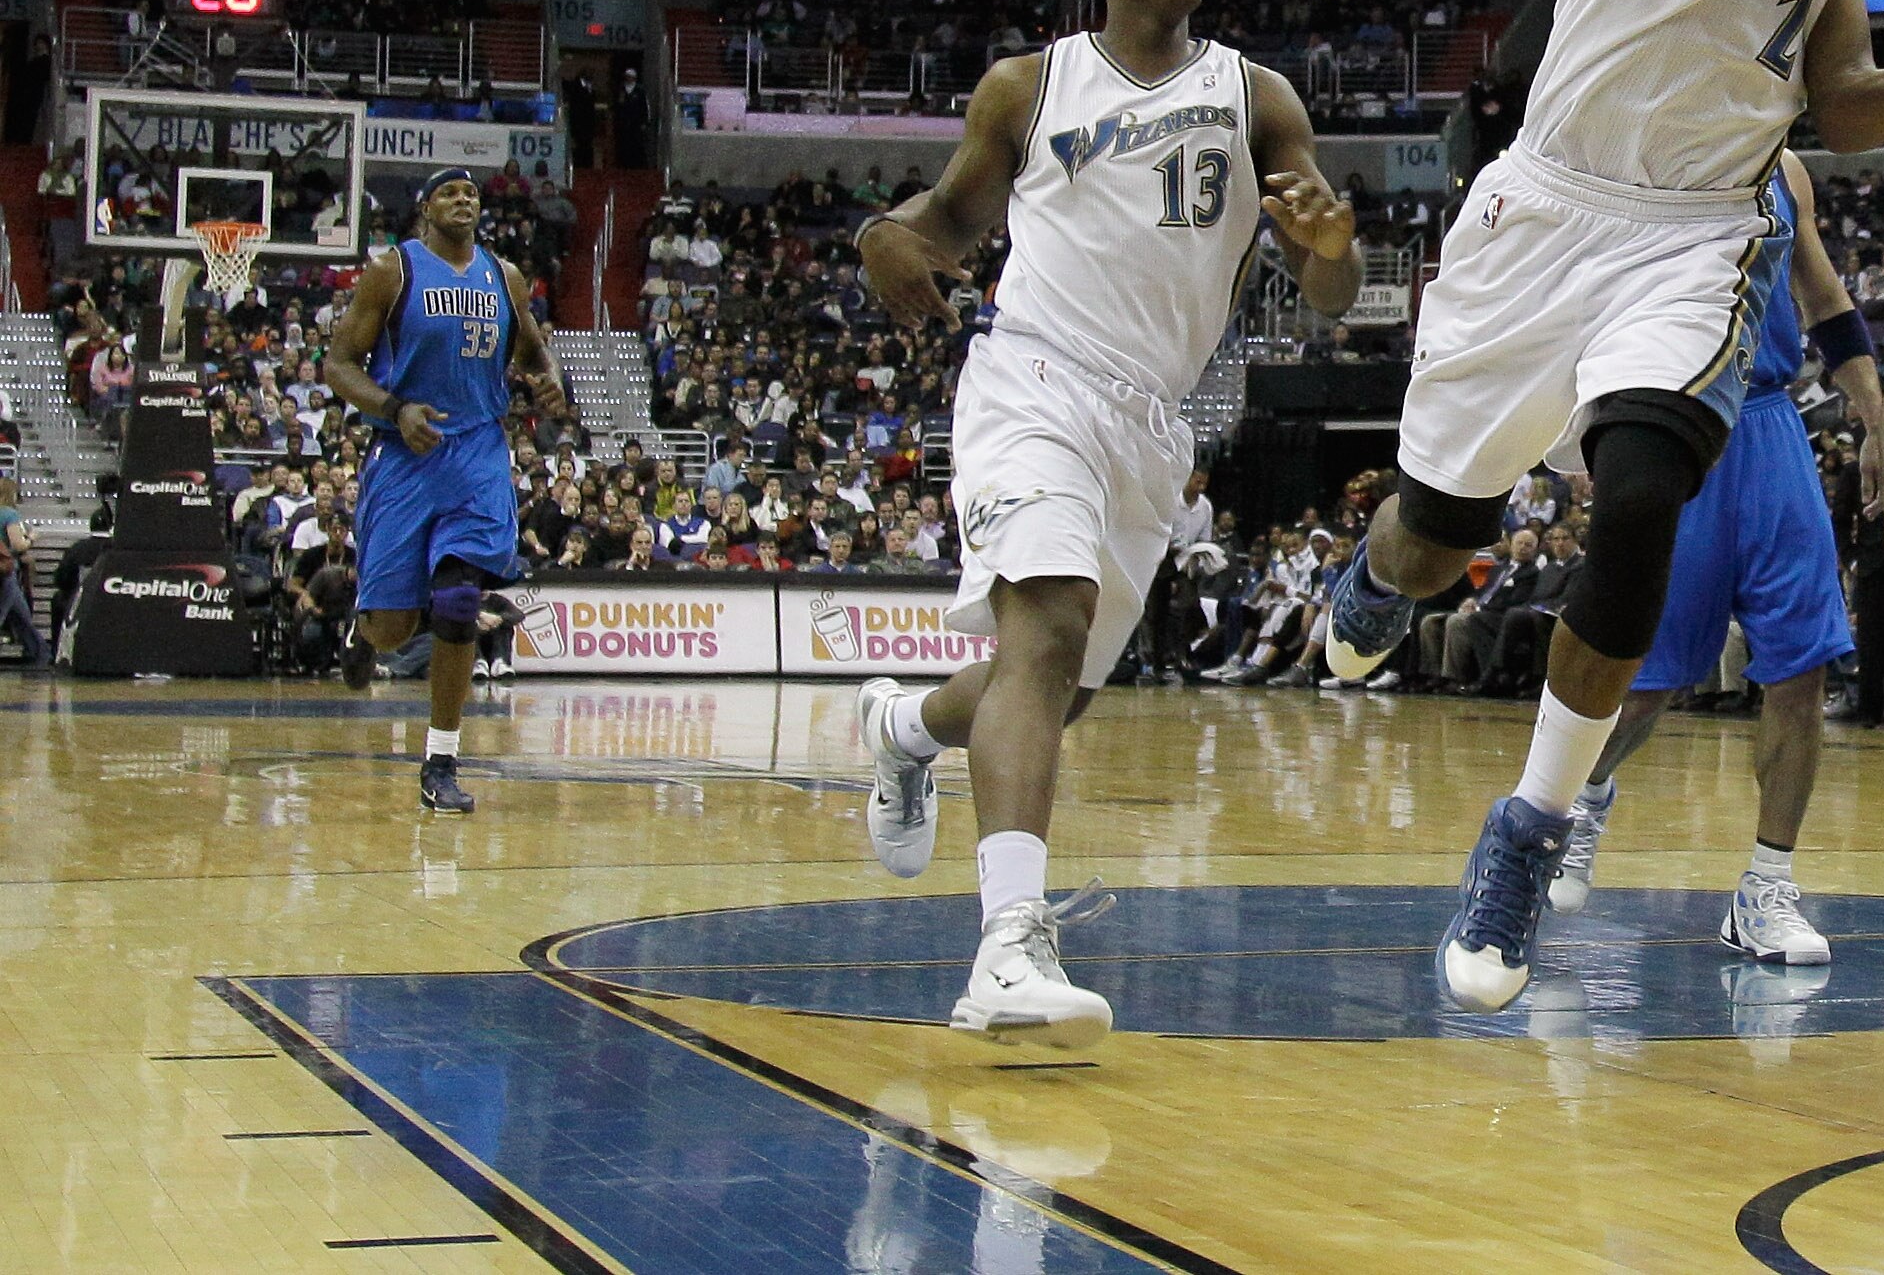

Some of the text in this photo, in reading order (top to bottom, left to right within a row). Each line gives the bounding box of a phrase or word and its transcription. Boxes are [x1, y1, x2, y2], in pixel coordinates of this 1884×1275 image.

[554, 1, 594, 19] 105
[158, 118, 304, 152] BLACHE'S
[364, 128, 433, 157] UNCH
[509, 131, 553, 157] 105
[1395, 145, 1438, 166] 104
[1153, 145, 1231, 228] 13
[423, 287, 498, 320] DALLAS
[461, 321, 499, 358] 33
[149, 370, 196, 383] SPALDING
[182, 408, 207, 417] Bank
[181, 496, 212, 506] Bank
[185, 604, 233, 621] Bank
[572, 602, 724, 629] DUNKIN'
[573, 632, 718, 658] DONUTS
